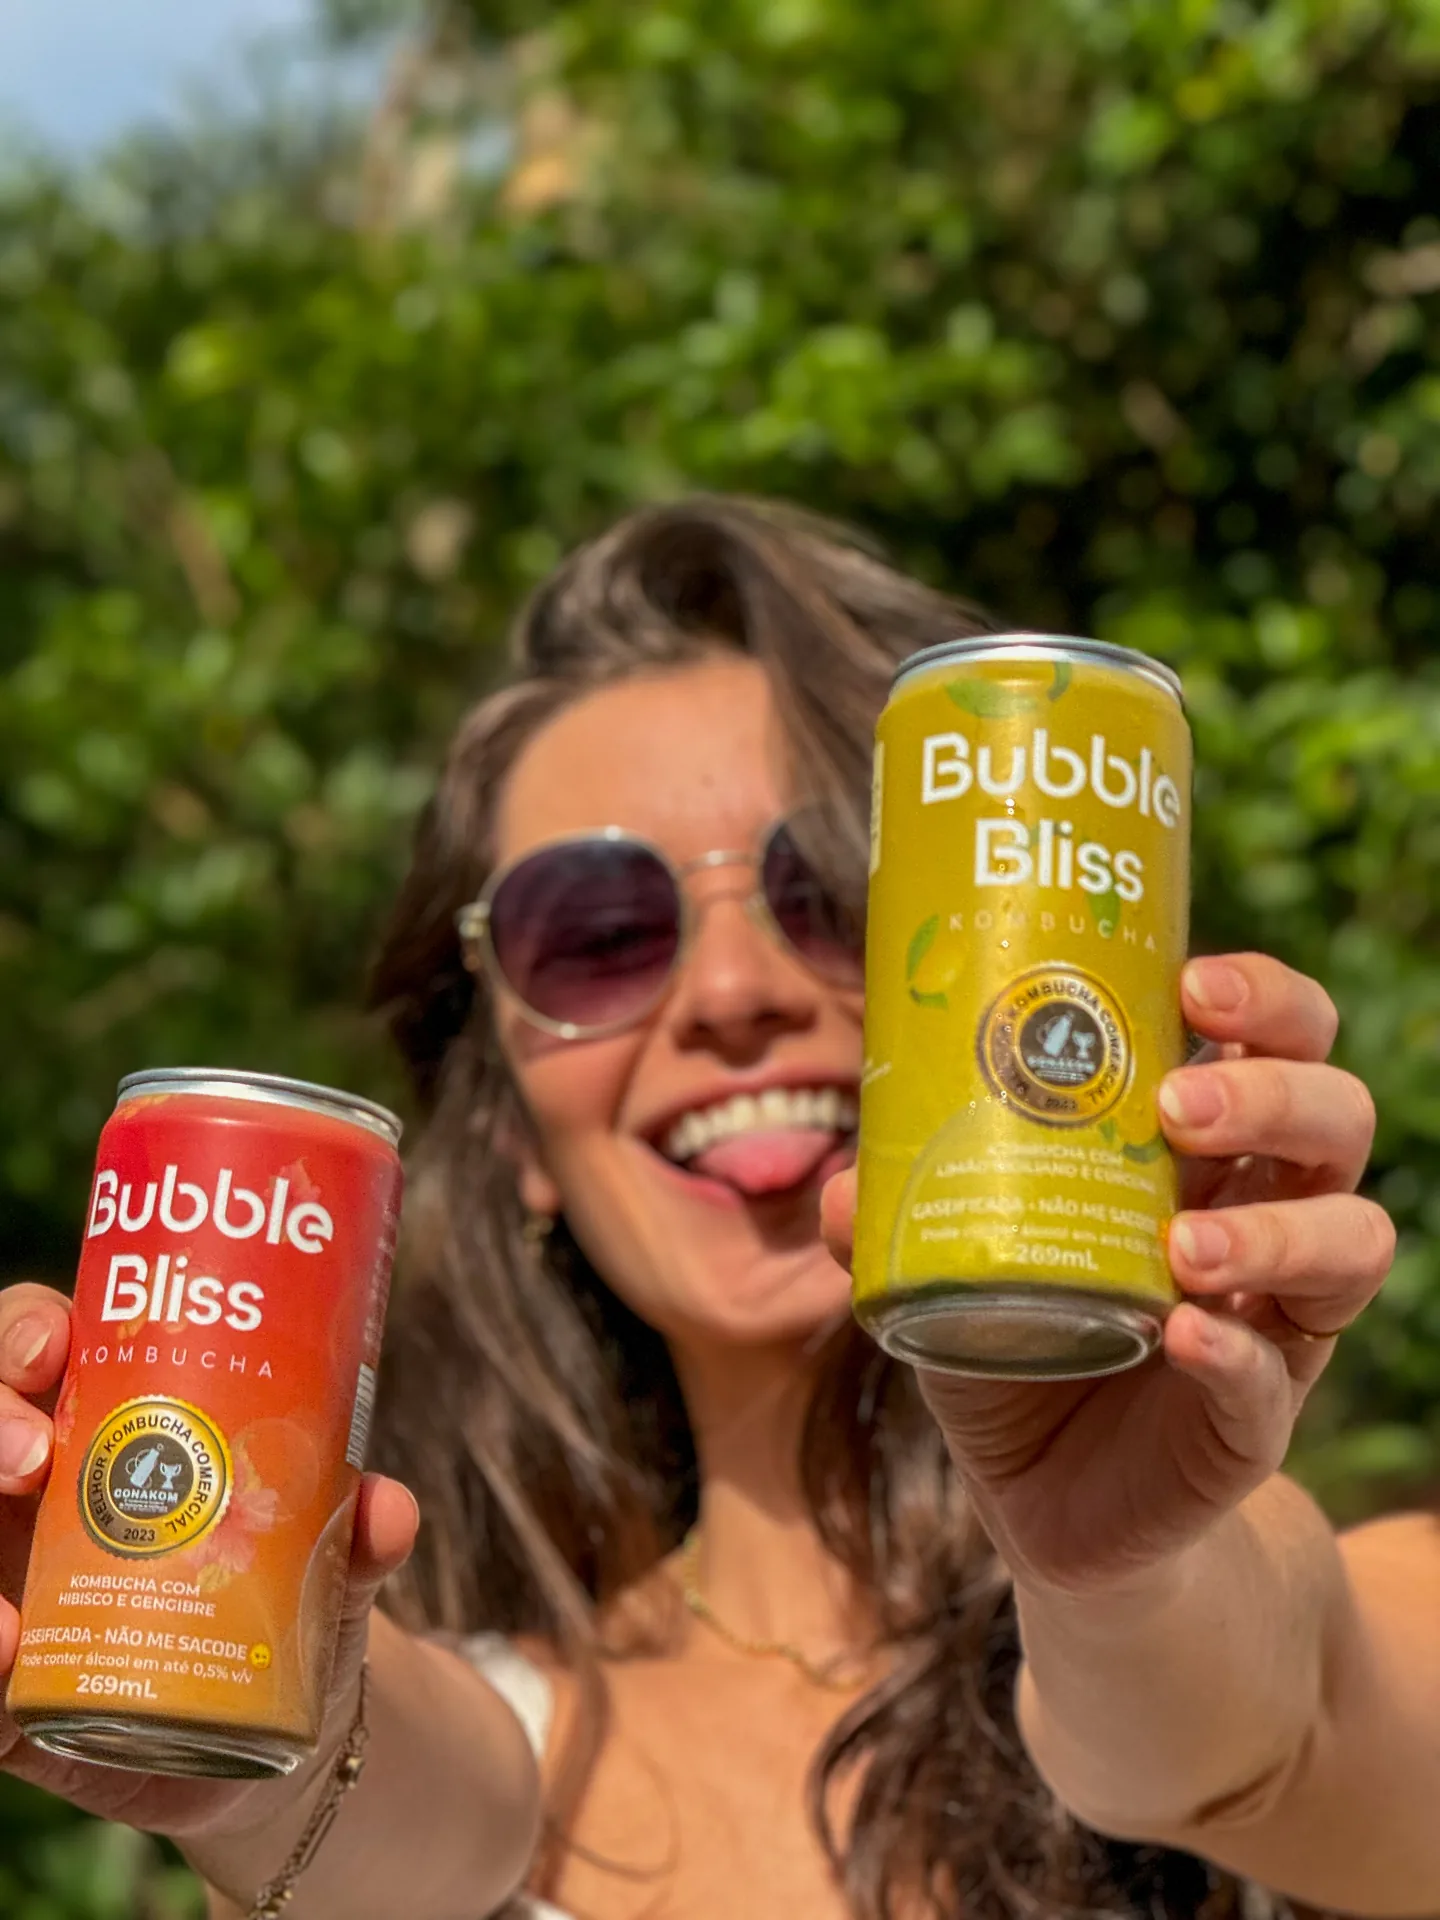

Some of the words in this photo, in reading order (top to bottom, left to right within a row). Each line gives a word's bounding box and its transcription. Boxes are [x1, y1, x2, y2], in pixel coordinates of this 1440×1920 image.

[921, 728, 1180, 828] Bubble
[974, 817, 1144, 901] Bliss
[949, 909, 1157, 954] KOMBUCHA
[88, 1165, 333, 1254] Bubble
[1038, 1194, 1079, 1217] NÃO
[1015, 1243, 1099, 1271] 269mL
[101, 1254, 264, 1331] Bliss
[80, 1345, 272, 1379] KOMBUCHA
[92, 1457, 114, 1526] MELHOR
[103, 1414, 192, 1452] KOMBUCHA
[165, 1441, 212, 1533] COMERCIAL
[114, 1488, 178, 1503] CONAKOM
[124, 1528, 155, 1542] 2023
[70, 1575, 157, 1592] KOMBUCHA
[161, 1580, 200, 1597] COM
[58, 1592, 113, 1606] HIBISCO
[117, 1594, 127, 1607] E
[130, 1595, 216, 1618] GENGIBRE
[104, 1625, 143, 1647] NÃO
[146, 1631, 176, 1650] ME
[178, 1636, 248, 1660] SACODE
[44, 1652, 83, 1666] conter
[86, 1651, 129, 1667] álcool
[133, 1658, 159, 1671] em
[163, 1660, 189, 1675] até
[193, 1663, 228, 1680] 0,5%
[231, 1668, 253, 1684] v/v
[76, 1674, 158, 1699] 269mL
